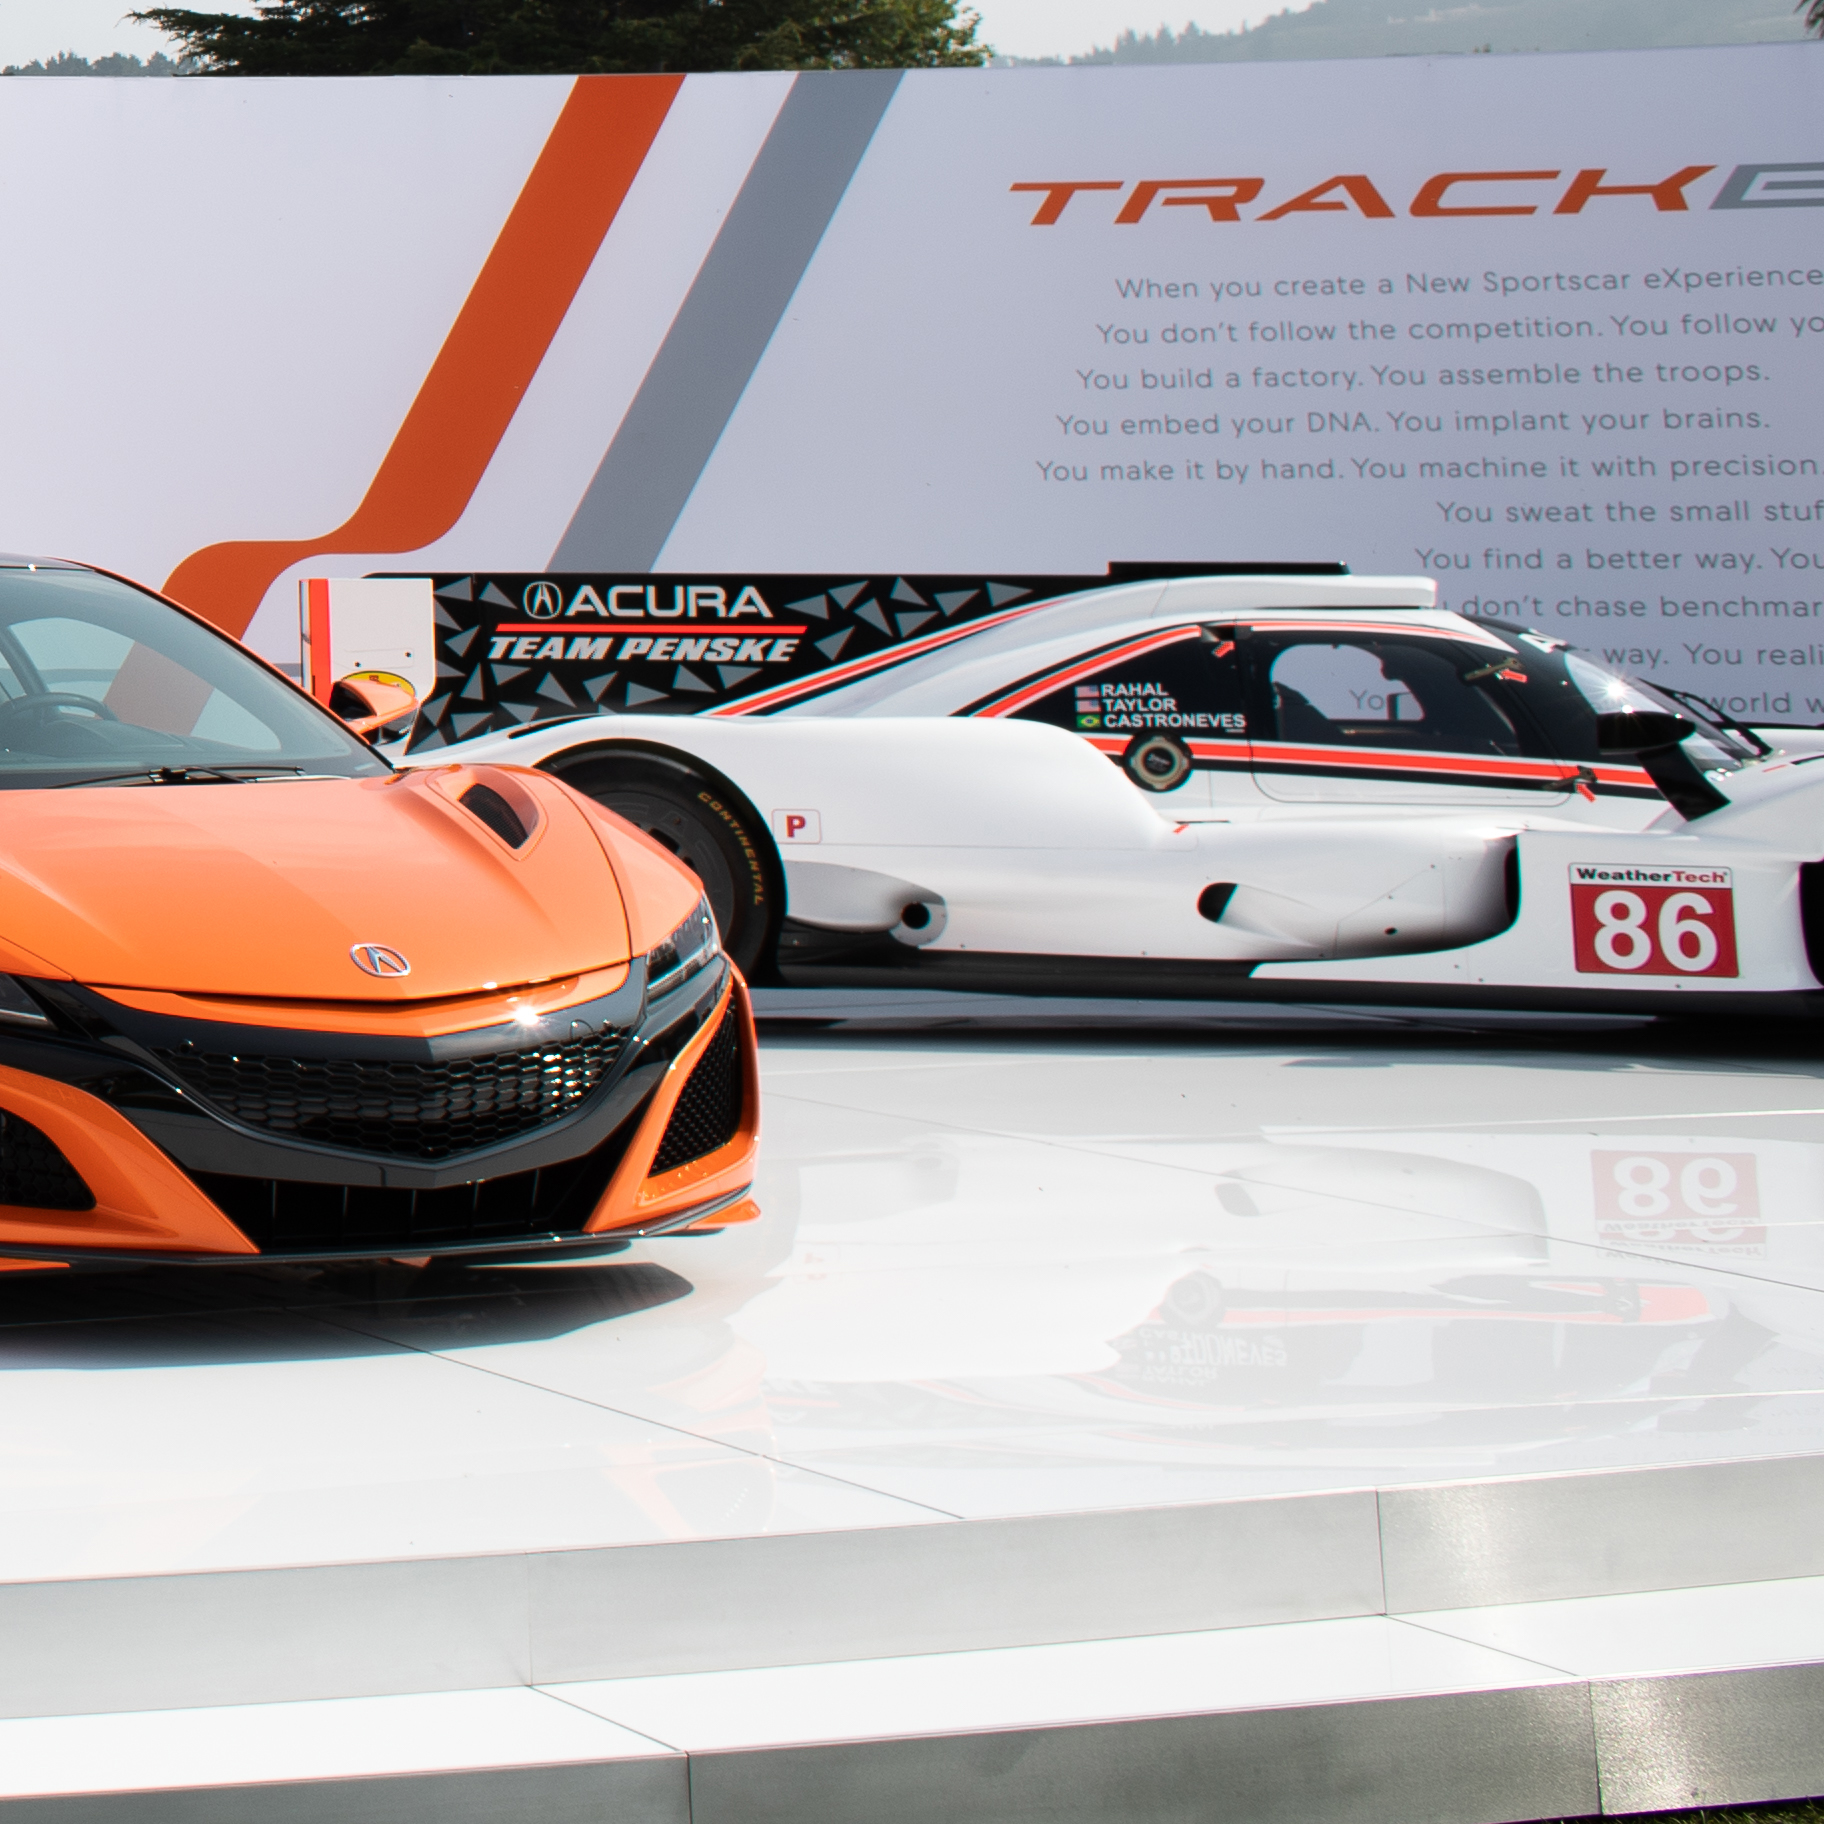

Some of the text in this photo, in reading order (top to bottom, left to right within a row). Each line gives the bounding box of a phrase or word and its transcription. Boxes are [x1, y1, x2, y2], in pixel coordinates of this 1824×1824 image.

[1115, 266, 1824, 302] When you create a New Sportscar eXperience
[1095, 324, 1148, 344] You
[1160, 322, 1237, 343] don't
[1248, 321, 1335, 343] follow
[1347, 320, 1395, 340] the
[1408, 318, 1603, 344] competition.
[1609, 315, 1668, 336] You
[1680, 313, 1776, 335] follow
[1076, 362, 1769, 392] You build a factory. You assemble the troops.
[1056, 407, 1769, 439] You embed your DNA. You implant your brains.
[1036, 461, 1088, 482] You
[1100, 460, 1173, 481] make
[1186, 459, 1203, 480] it
[1216, 459, 1249, 485] by
[1261, 458, 1343, 480] hand.
[1350, 457, 1406, 478] You
[1419, 456, 1546, 478] machine
[1559, 456, 1579, 477] it
[1591, 455, 1656, 477] with
[1436, 502, 1491, 523] You
[1506, 503, 1593, 523] sweat
[1605, 501, 1656, 522] the
[1670, 500, 1749, 522] small
[1414, 548, 1469, 569] You
[1482, 548, 1542, 569] find
[1557, 553, 1572, 569] a
[1586, 548, 1682, 570] better
[1694, 551, 1762, 574] way.
[564, 585, 774, 618] ACURA
[1461, 595, 1543, 616] don't
[1556, 595, 1646, 617] chase
[1660, 596, 1823, 617] benchmar
[487, 636, 800, 663] TEAM PENSKE
[1602, 648, 1669, 669] way.
[1683, 643, 1741, 665] You
[1101, 682, 1170, 697] RAHAL
[1349, 689, 1387, 710] Yo
[1103, 698, 1178, 713] TAYLOR
[1103, 713, 1248, 729] CASTRONEVES
[785, 814, 807, 839] P
[698, 791, 765, 906] CONTINENTAL
[1576, 867, 1726, 884] WeatherTech
[1593, 889, 1719, 973] 86
